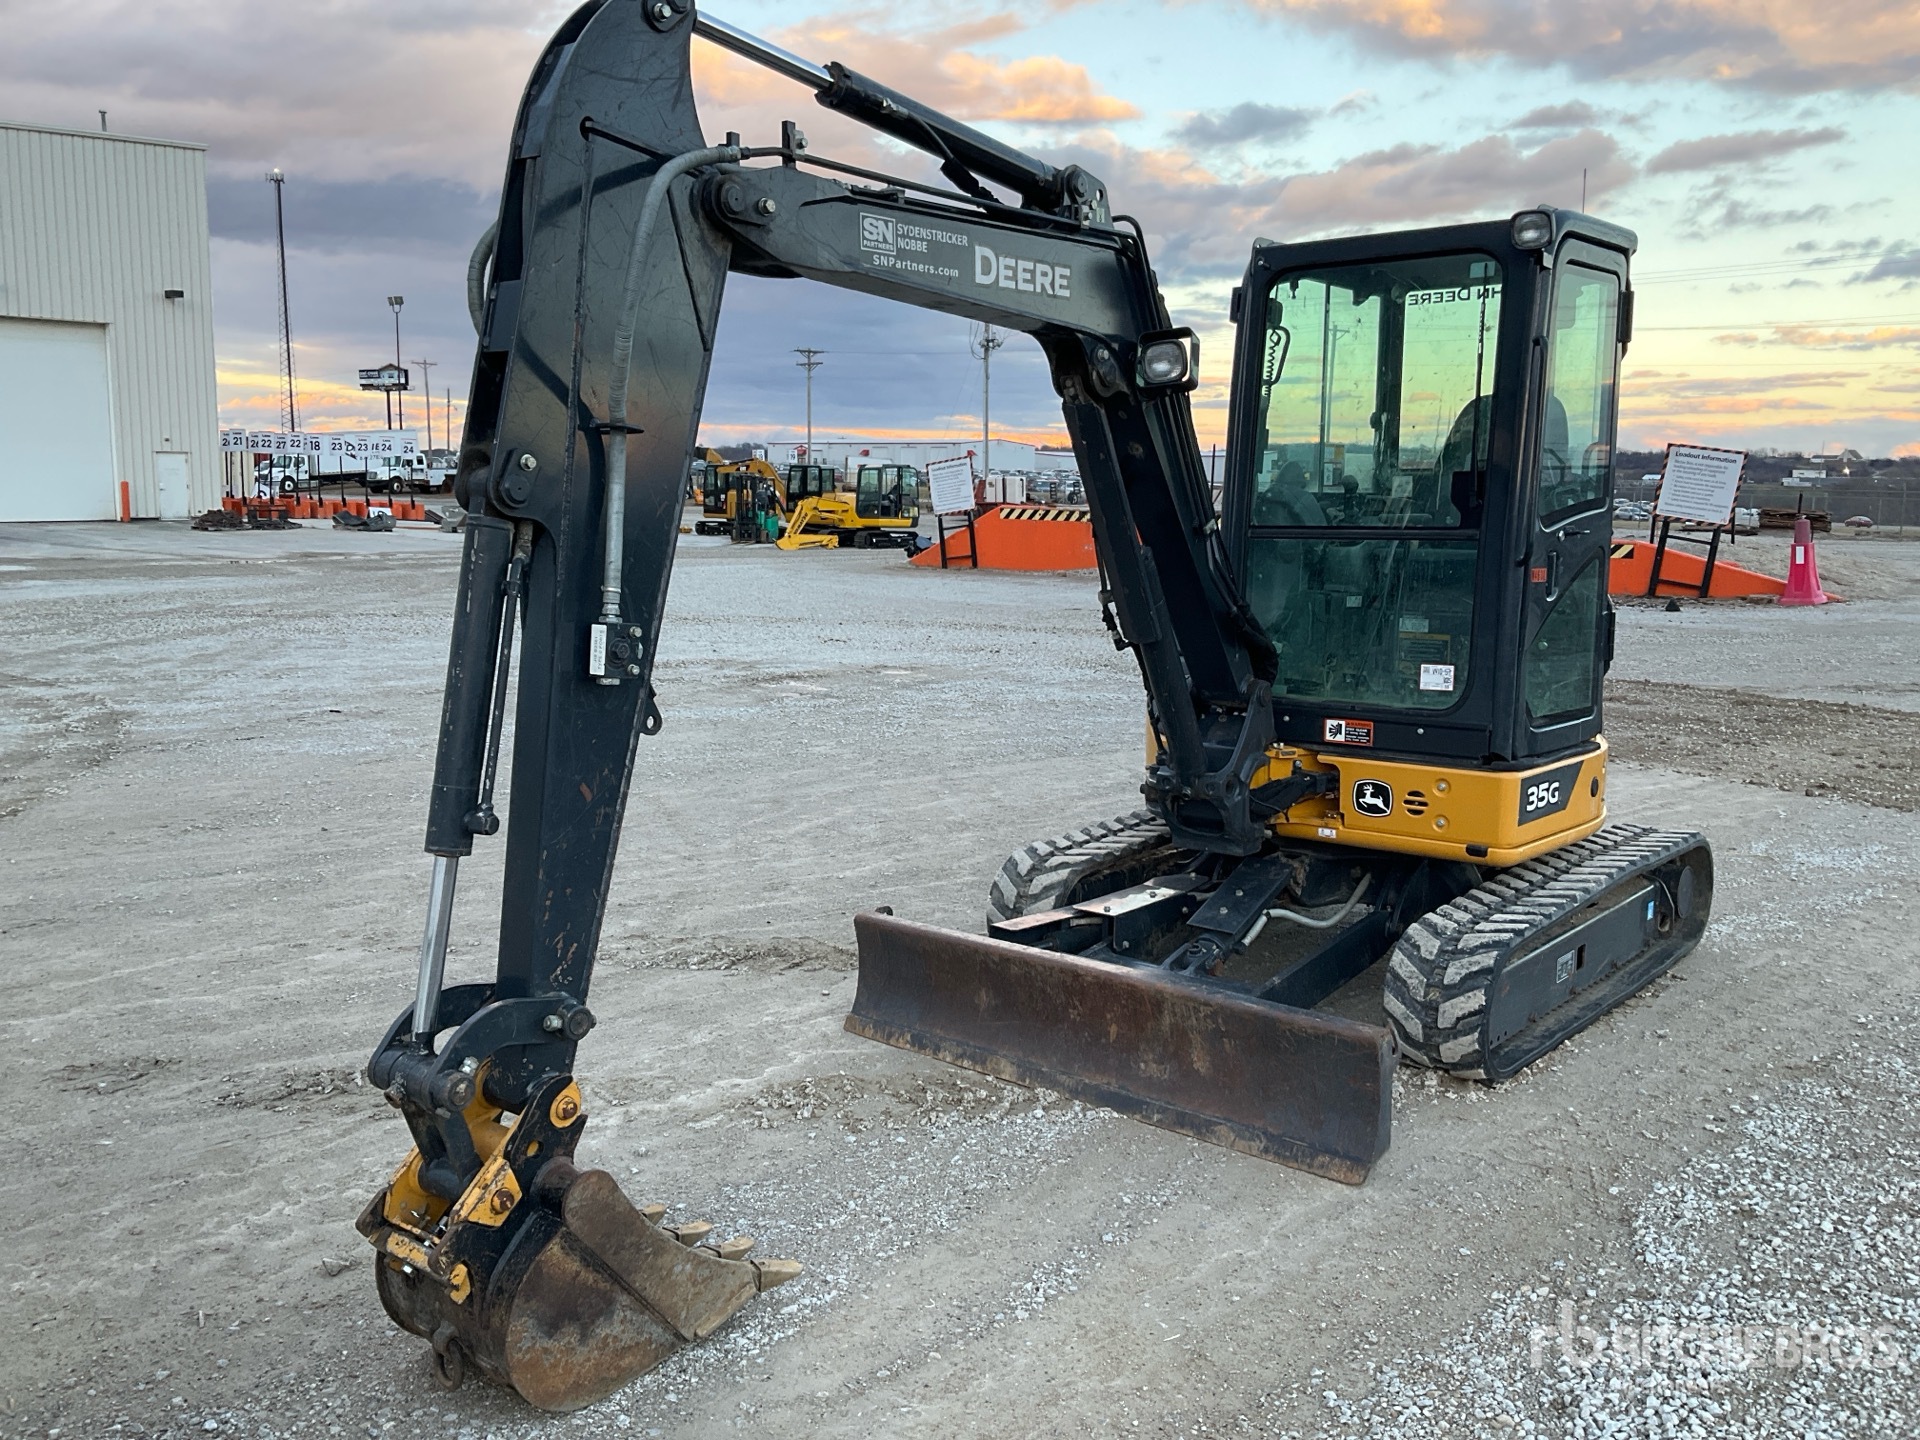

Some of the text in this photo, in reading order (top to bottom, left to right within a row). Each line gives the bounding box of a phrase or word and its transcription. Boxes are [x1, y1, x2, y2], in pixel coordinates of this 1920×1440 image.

[863, 217, 893, 244] SN
[896, 223, 968, 247] SYDENSTRICKER
[863, 240, 894, 251] PARTNERS
[897, 237, 928, 253] NOBBE
[872, 254, 959, 278] SNPartners.com
[974, 245, 1071, 298] DEERE
[232, 436, 243, 446] 21
[260, 439, 272, 448] 22
[275, 440, 287, 449] 27
[289, 439, 301, 448] 22
[309, 440, 321, 451] 18
[331, 442, 343, 451] 23
[357, 443, 369, 452] 23
[381, 443, 392, 452] 24
[403, 446, 414, 454] 24
[1675, 450, 1737, 464] Loadout Information
[1526, 782, 1560, 811] 35G
